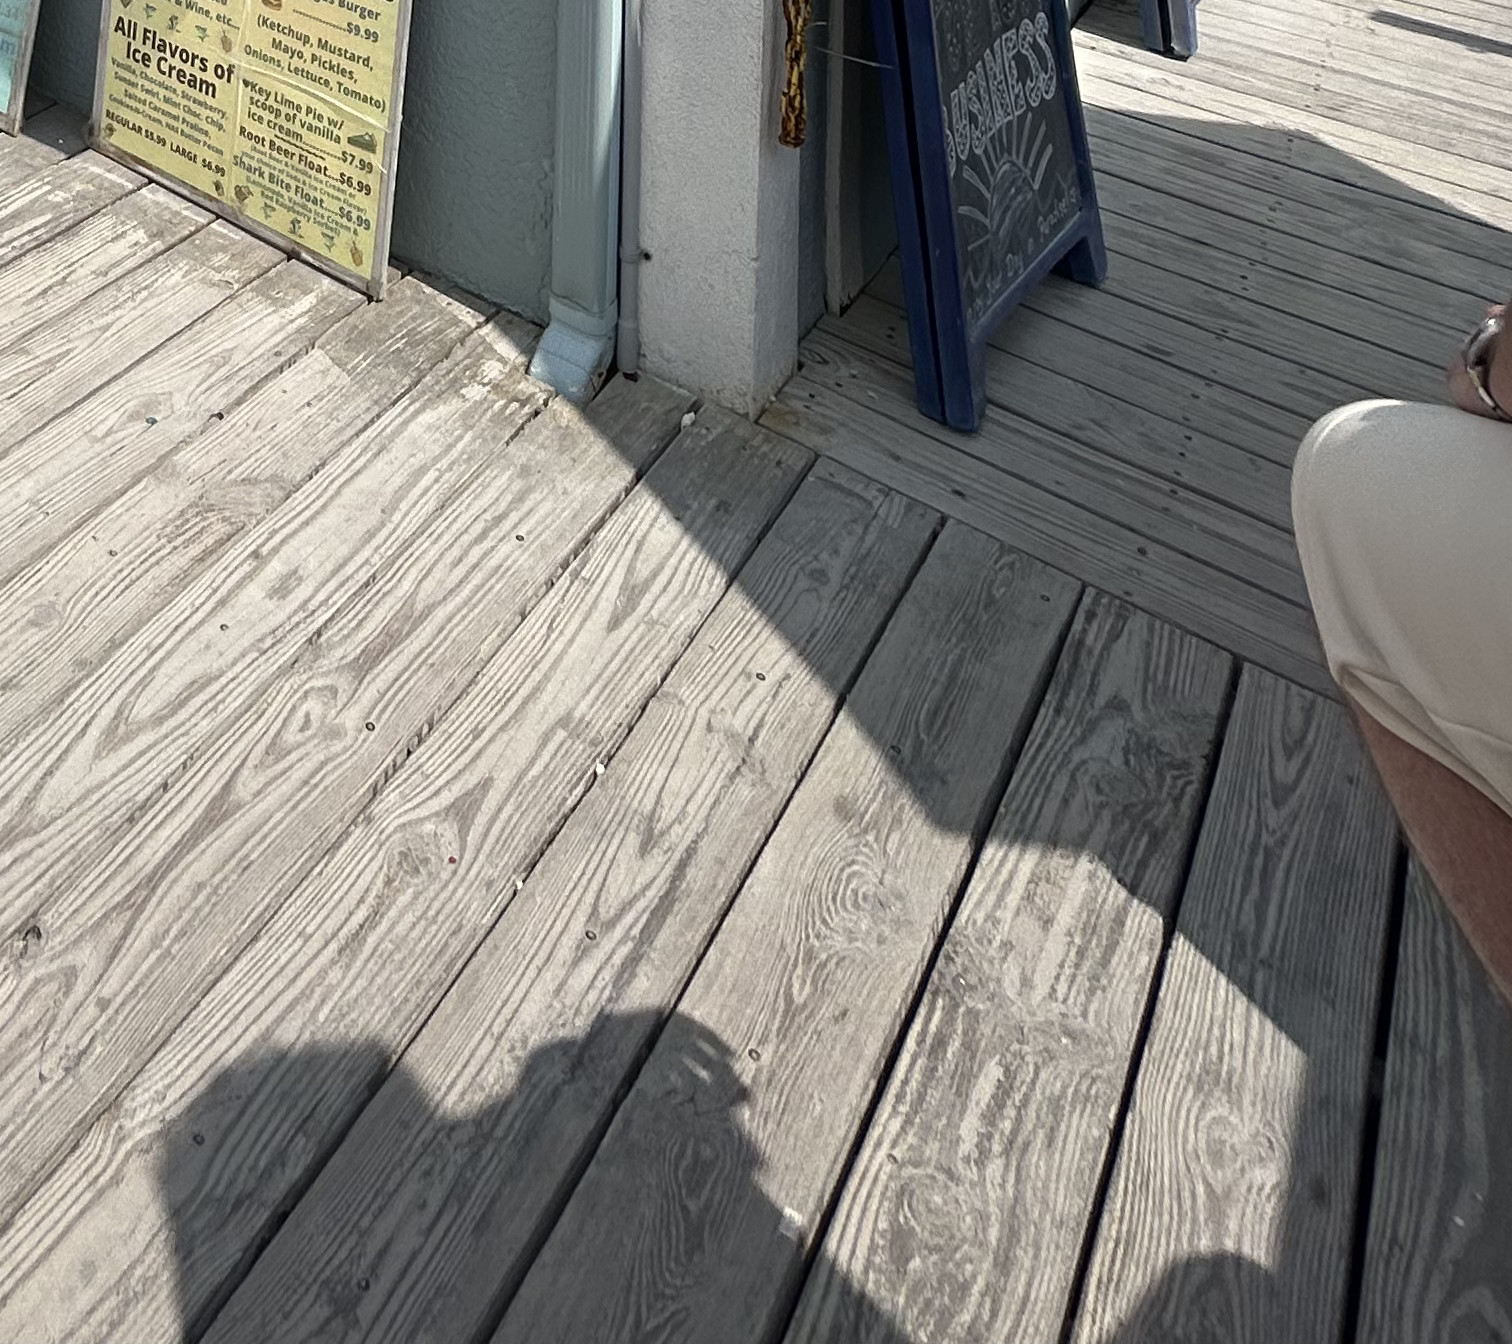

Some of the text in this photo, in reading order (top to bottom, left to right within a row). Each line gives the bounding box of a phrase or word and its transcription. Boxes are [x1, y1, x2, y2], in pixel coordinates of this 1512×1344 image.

[114, 15, 236, 84] All Flavors of
[257, 13, 374, 72] (Ketchup, Mustard,
[271, 37, 358, 84] Mayo, Pickles,
[126, 41, 217, 99] Ice Cream
[244, 44, 387, 113] Onions, Lettuce, Tomato)
[247, 107, 264, 125] ice
[249, 80, 345, 131] Key Lime Pie w/
[249, 95, 342, 145] scoop of vanilla
[105, 109, 226, 177] REGULAR $5.99 LARGE $6.99
[239, 125, 266, 147] Root
[269, 139, 295, 161] Beer
[232, 154, 265, 180] Shark
[268, 172, 292, 193] Bite
